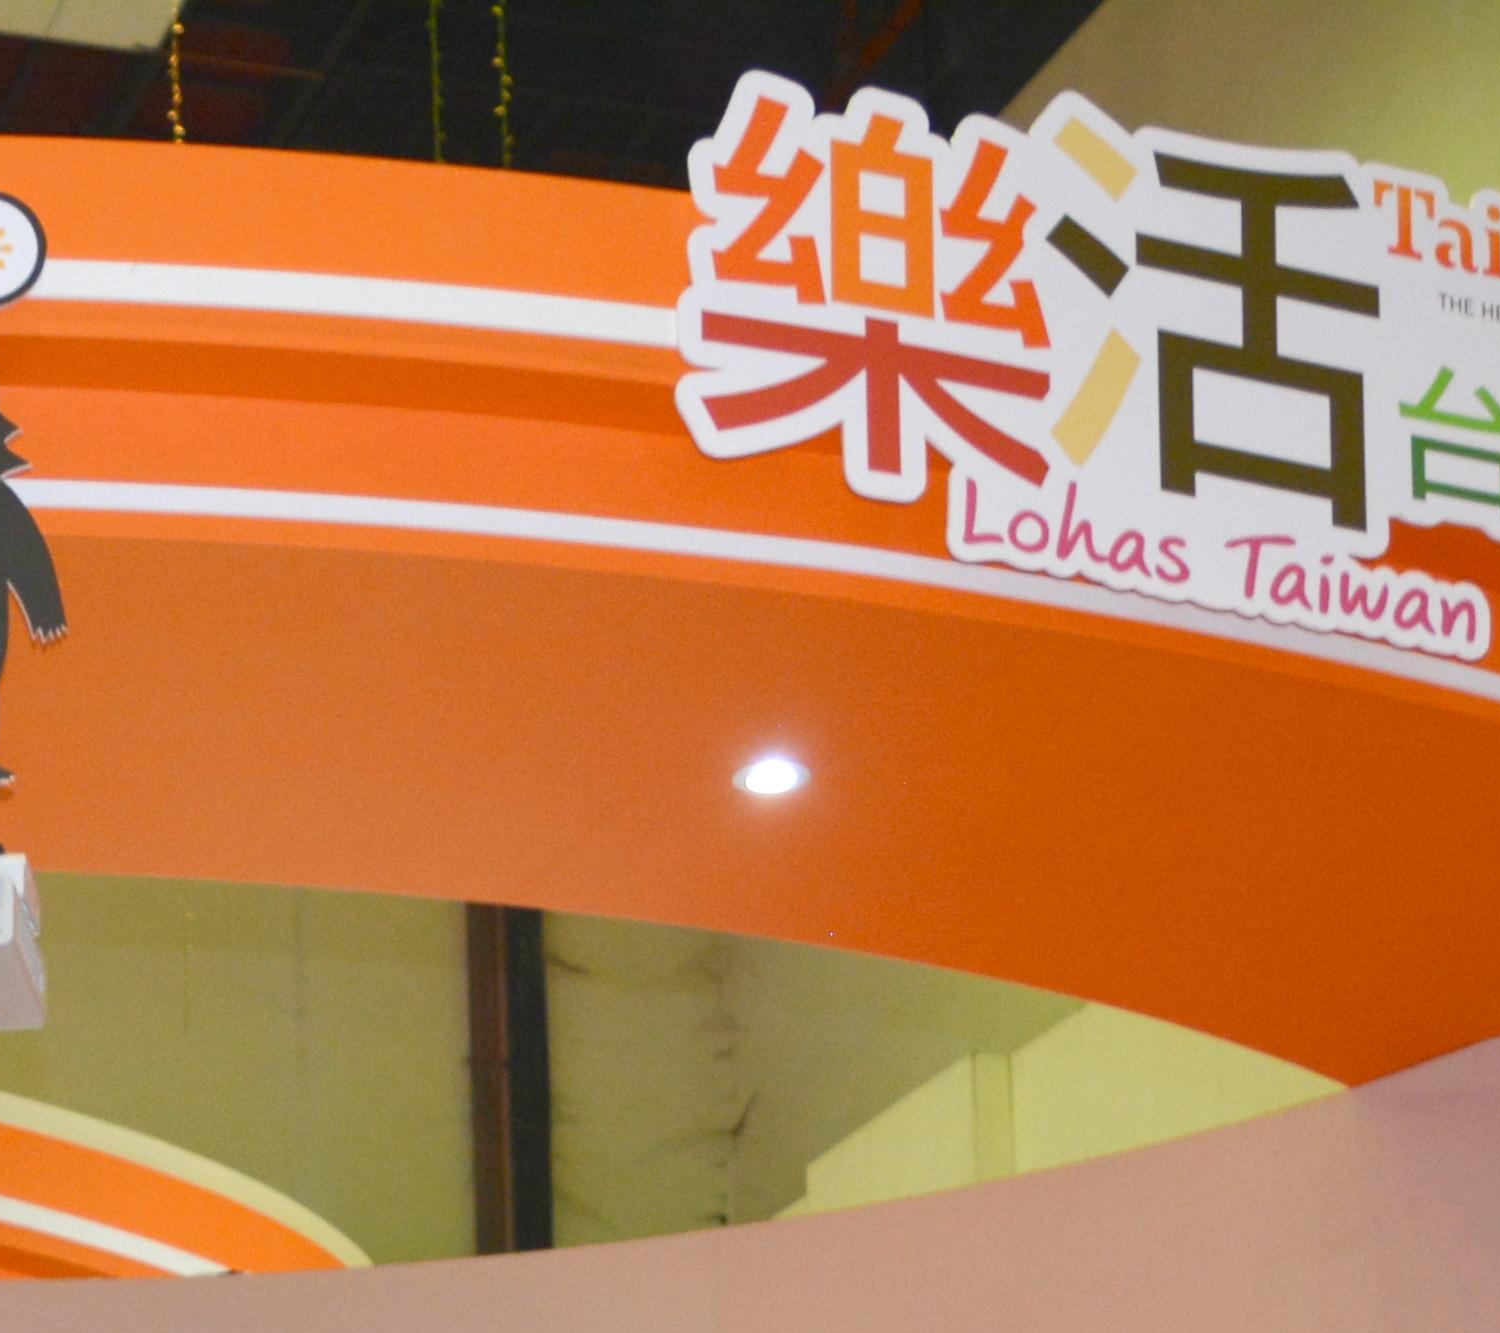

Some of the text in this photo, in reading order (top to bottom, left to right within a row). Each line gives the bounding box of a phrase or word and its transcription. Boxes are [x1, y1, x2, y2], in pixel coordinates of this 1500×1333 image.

[699, 94, 1381, 533] 樂活
[1437, 291, 1473, 317] THE
[962, 476, 1478, 648] Lohas Taiwan
